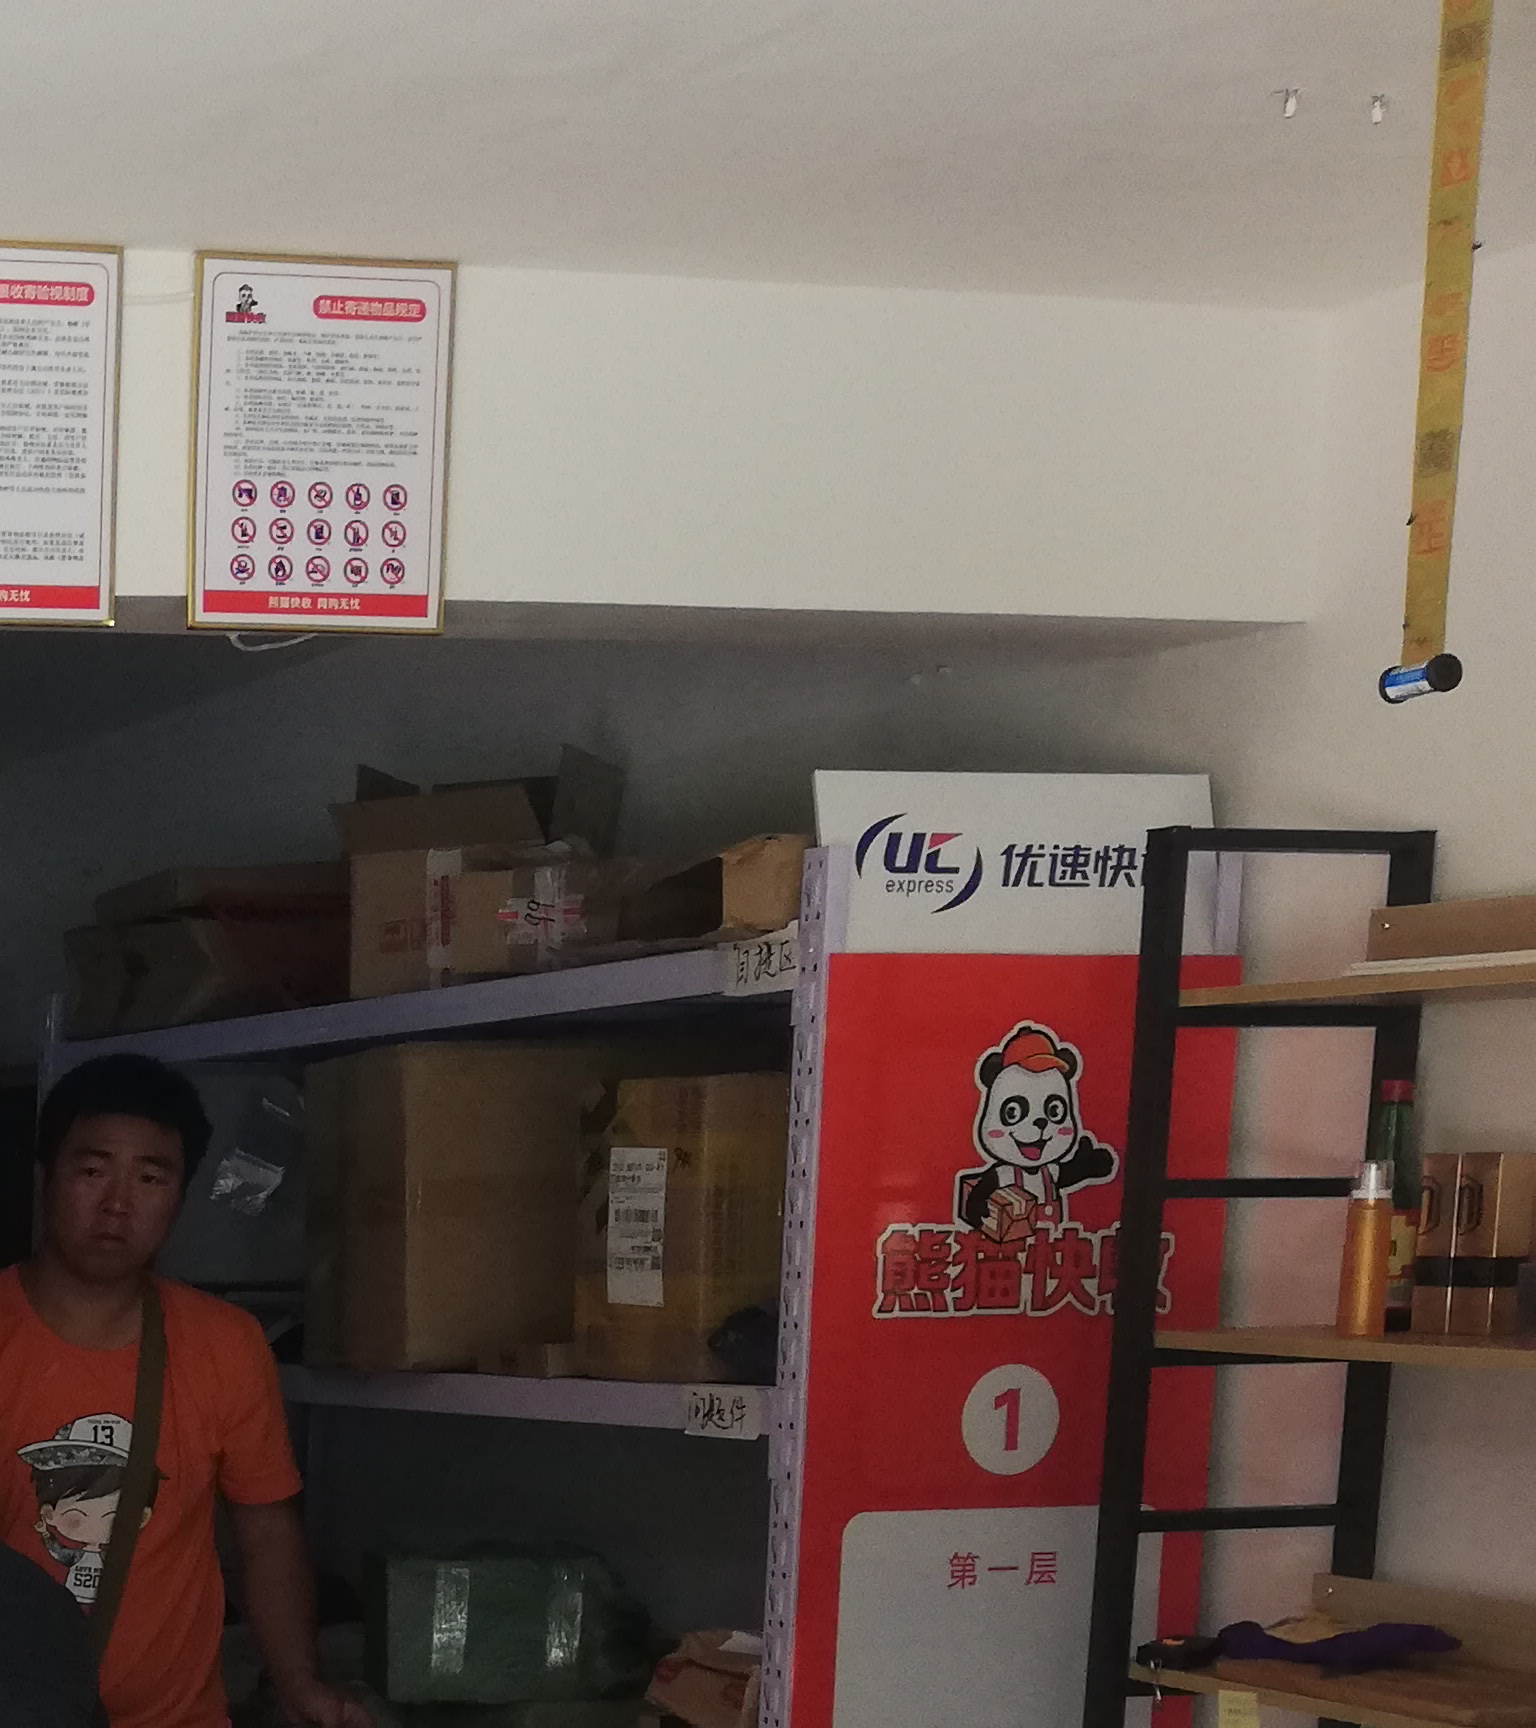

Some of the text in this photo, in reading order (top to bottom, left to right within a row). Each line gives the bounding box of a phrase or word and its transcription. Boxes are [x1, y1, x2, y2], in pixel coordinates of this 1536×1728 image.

[885, 875, 955, 897] express
[999, 843, 1147, 889] 优速快
[92, 1424, 115, 1447] 13
[992, 1387, 1023, 1452] 1
[947, 1550, 1059, 1591] 第一层
